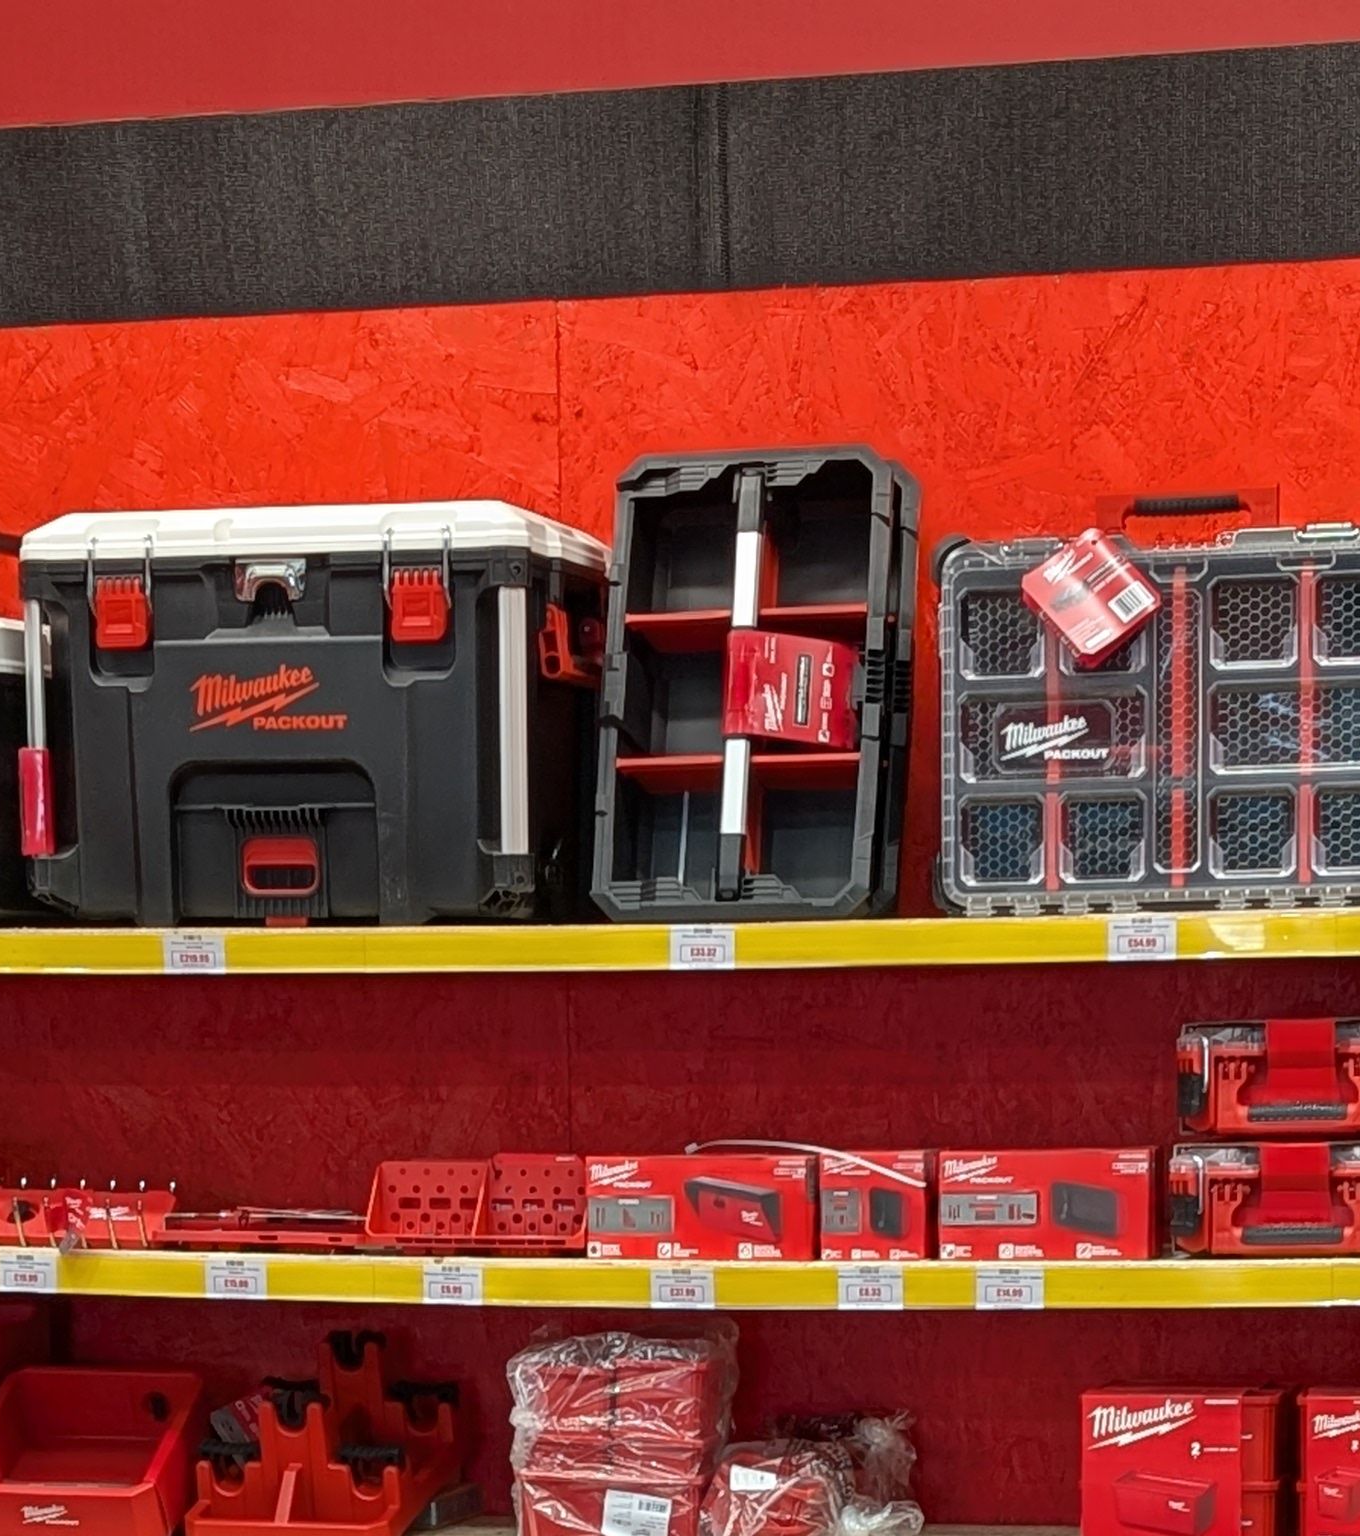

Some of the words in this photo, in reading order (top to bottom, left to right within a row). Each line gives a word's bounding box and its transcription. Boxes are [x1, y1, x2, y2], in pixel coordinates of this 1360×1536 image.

[190, 664, 314, 716] Milwaukee
[253, 713, 348, 731] PACKOUT
[1001, 715, 1088, 748] Milwaukee
[1043, 748, 1110, 760] PACKOUT
[589, 1160, 639, 1182] Milwaukee
[942, 1155, 999, 1176] Milwaukee
[1087, 1399, 1195, 1439] Milwaukee
